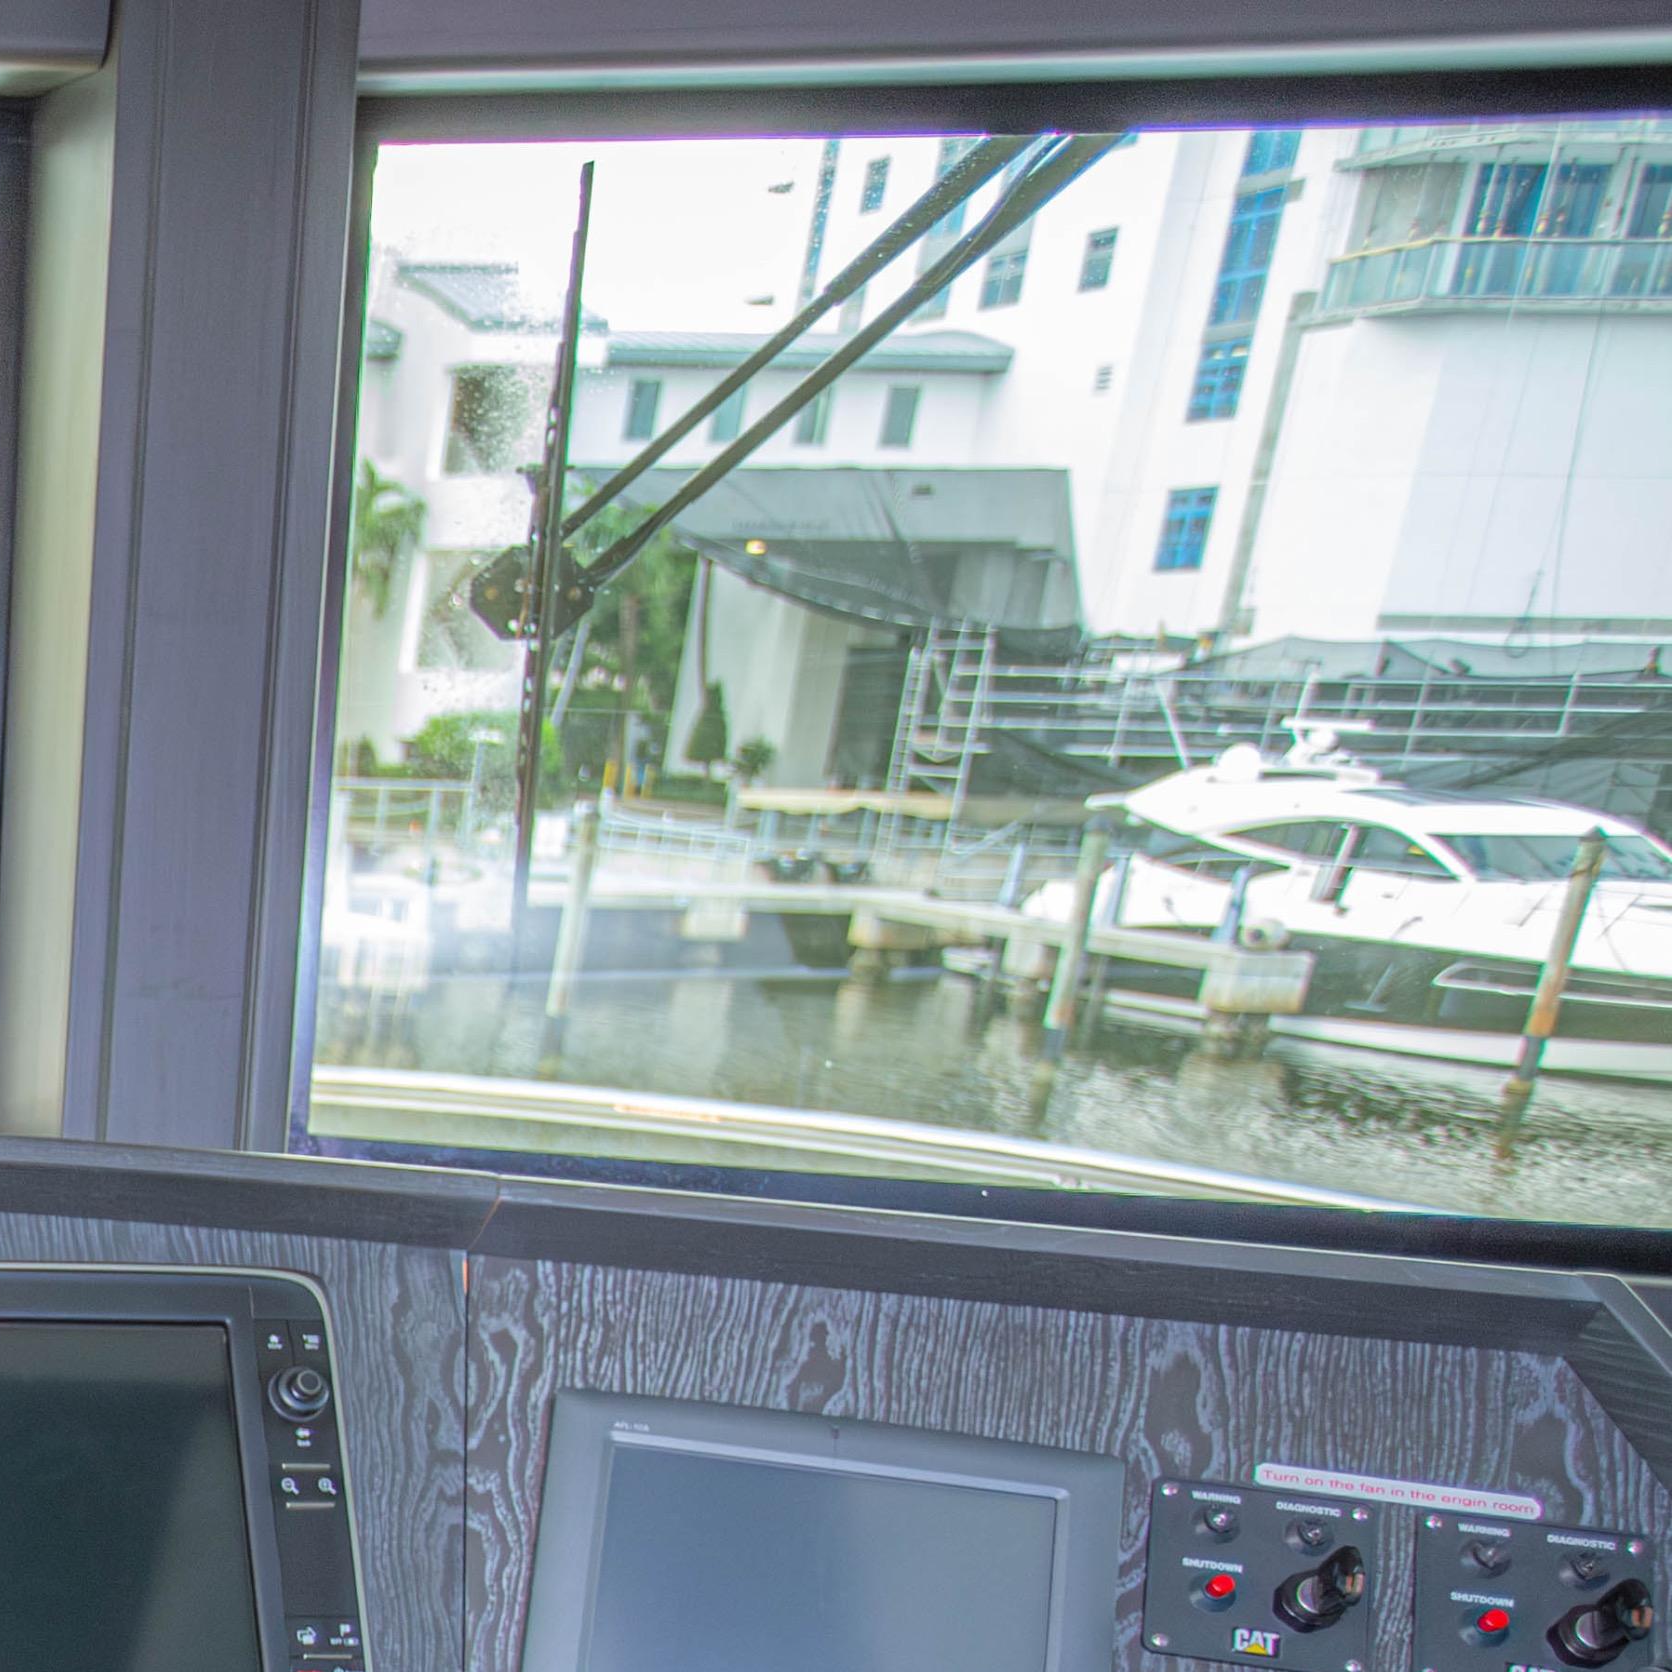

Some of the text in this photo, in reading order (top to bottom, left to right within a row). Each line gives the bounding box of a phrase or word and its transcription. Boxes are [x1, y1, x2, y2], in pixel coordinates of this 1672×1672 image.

[1191, 1490, 1242, 1505] WARNING
[1262, 1469, 1300, 1484] Turn
[1305, 1476, 1324, 1487] on
[1328, 1477, 1355, 1492] the
[1359, 1479, 1387, 1497] fan
[1390, 1485, 1406, 1499] in
[1410, 1488, 1437, 1502] the
[1492, 1500, 1536, 1516] room
[1275, 1500, 1342, 1518] DIAGNOSTIC
[1458, 1522, 1511, 1538] WARNING
[1546, 1533, 1617, 1551] DIAGNOSTIC
[1182, 1556, 1244, 1574] SHUTDOWN
[1450, 1591, 1515, 1608] SHUTDOWN
[1233, 1627, 1280, 1657] CAT
